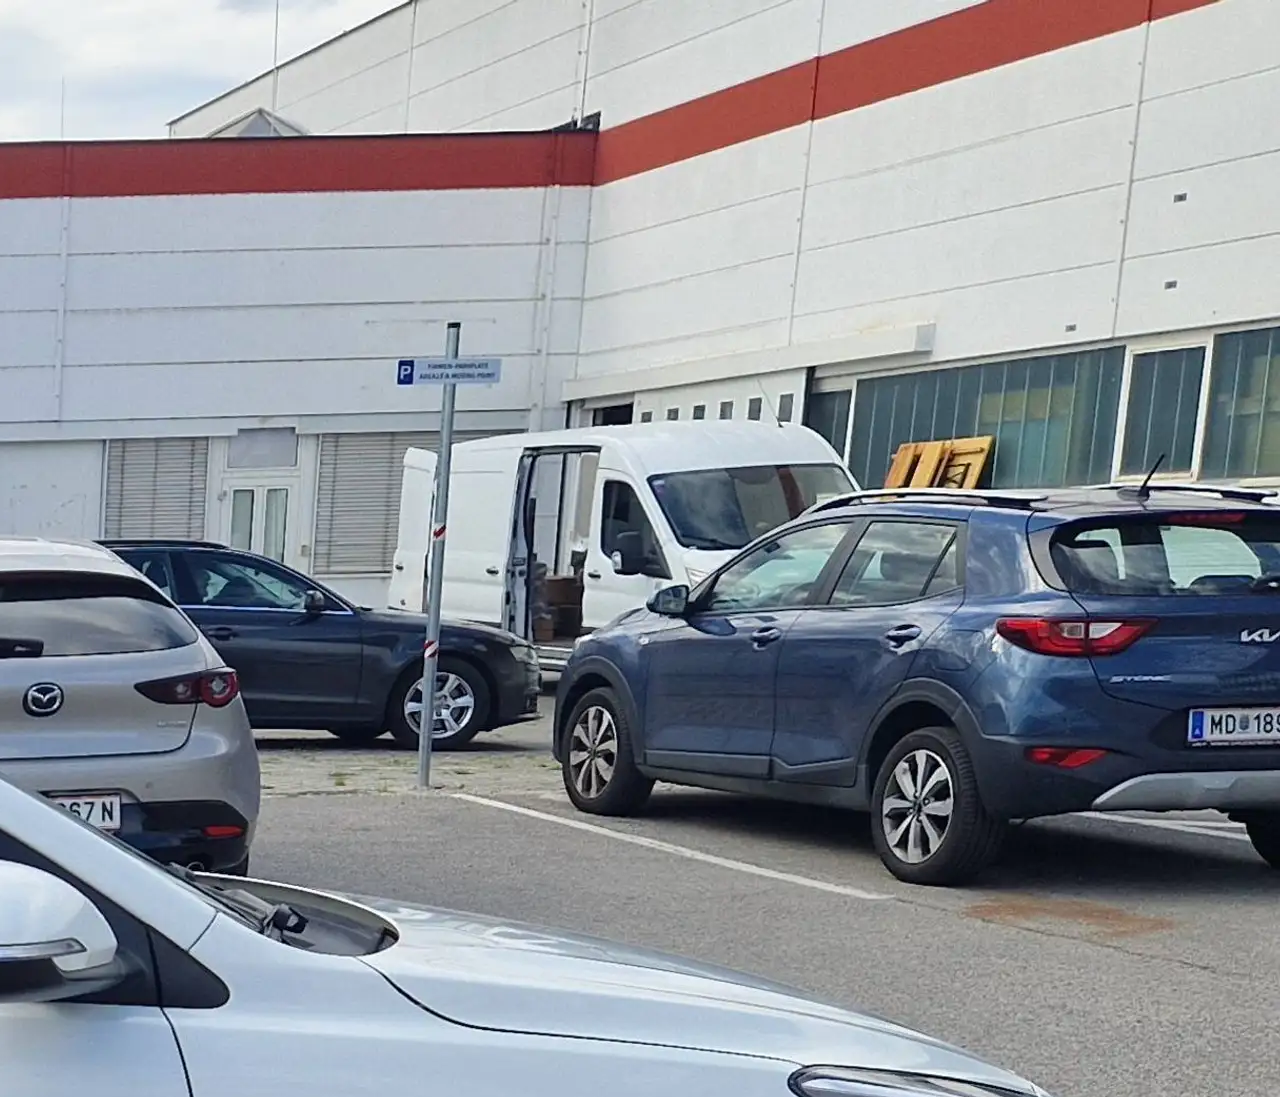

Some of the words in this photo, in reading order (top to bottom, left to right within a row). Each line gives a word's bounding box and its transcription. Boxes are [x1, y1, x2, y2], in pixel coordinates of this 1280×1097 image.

[400, 366, 411, 379] P
[1210, 713, 1237, 735] MD
[101, 800, 114, 822] N
